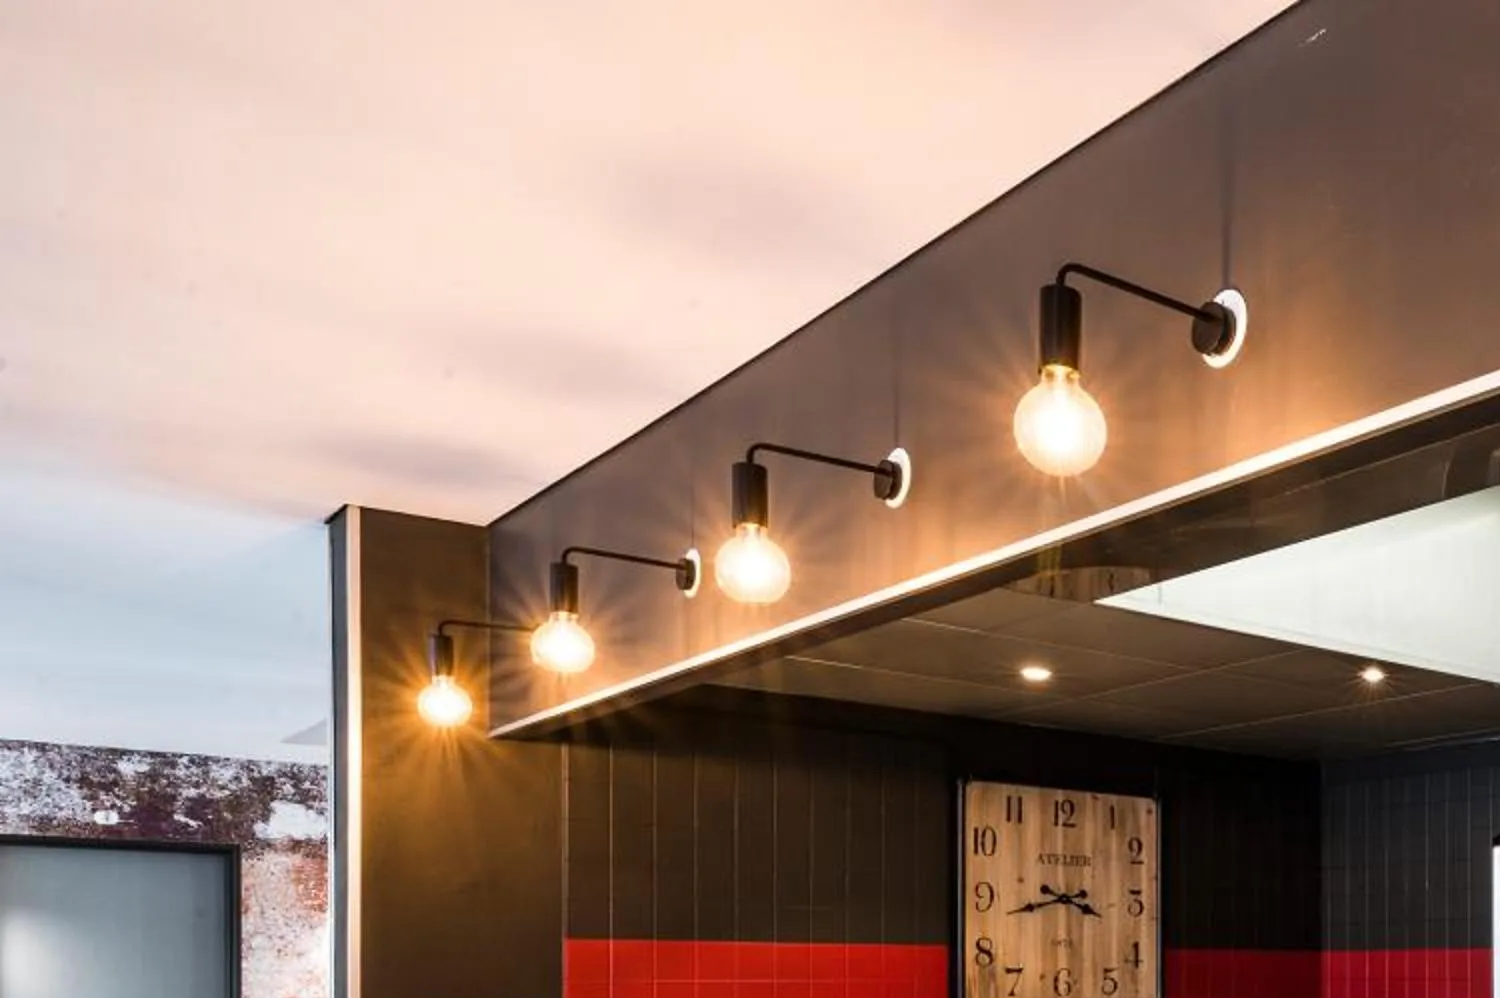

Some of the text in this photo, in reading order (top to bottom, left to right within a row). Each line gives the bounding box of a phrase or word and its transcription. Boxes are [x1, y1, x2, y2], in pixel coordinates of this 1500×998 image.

[1006, 796, 1023, 824] 11
[1053, 799, 1077, 827] 12
[1108, 805, 1116, 830] 1
[973, 826, 997, 857] 10
[1127, 837, 1144, 865] 2
[975, 881, 995, 913] 9
[1127, 889, 1144, 918] 3
[975, 937, 994, 968] 8
[1124, 941, 1144, 970] 4
[1005, 967, 1024, 997] 7
[1053, 967, 1072, 998] 6
[1101, 967, 1119, 996] 5
